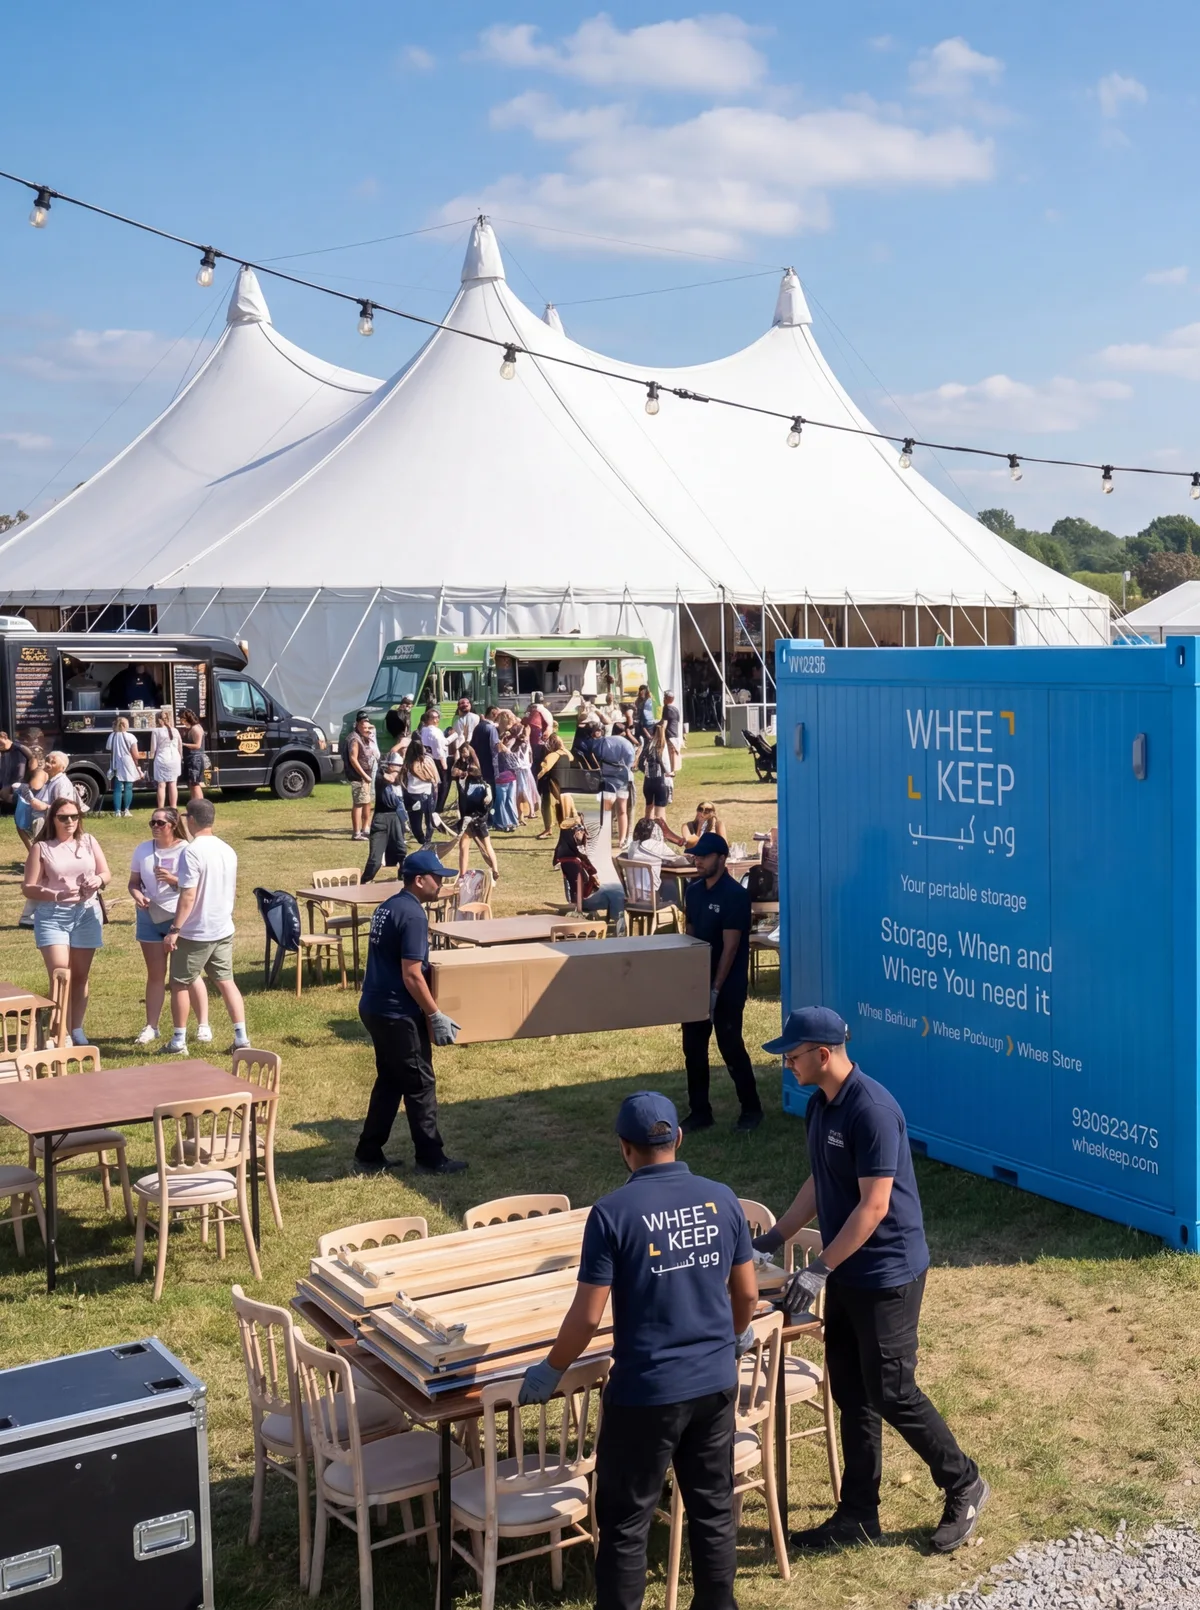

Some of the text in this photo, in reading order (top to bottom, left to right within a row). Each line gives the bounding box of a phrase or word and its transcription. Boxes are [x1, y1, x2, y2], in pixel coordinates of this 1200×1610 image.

[906, 709, 994, 753] WHEE
[937, 760, 1015, 806] KEEP
[900, 874, 926, 894] Your
[980, 888, 1027, 913] storage
[881, 917, 1053, 973] Storage, When and
[882, 954, 1051, 1016] Where You need it
[1052, 1050, 1082, 1072] Store
[641, 1205, 707, 1232] WHEE
[668, 1225, 719, 1251] KEEP
